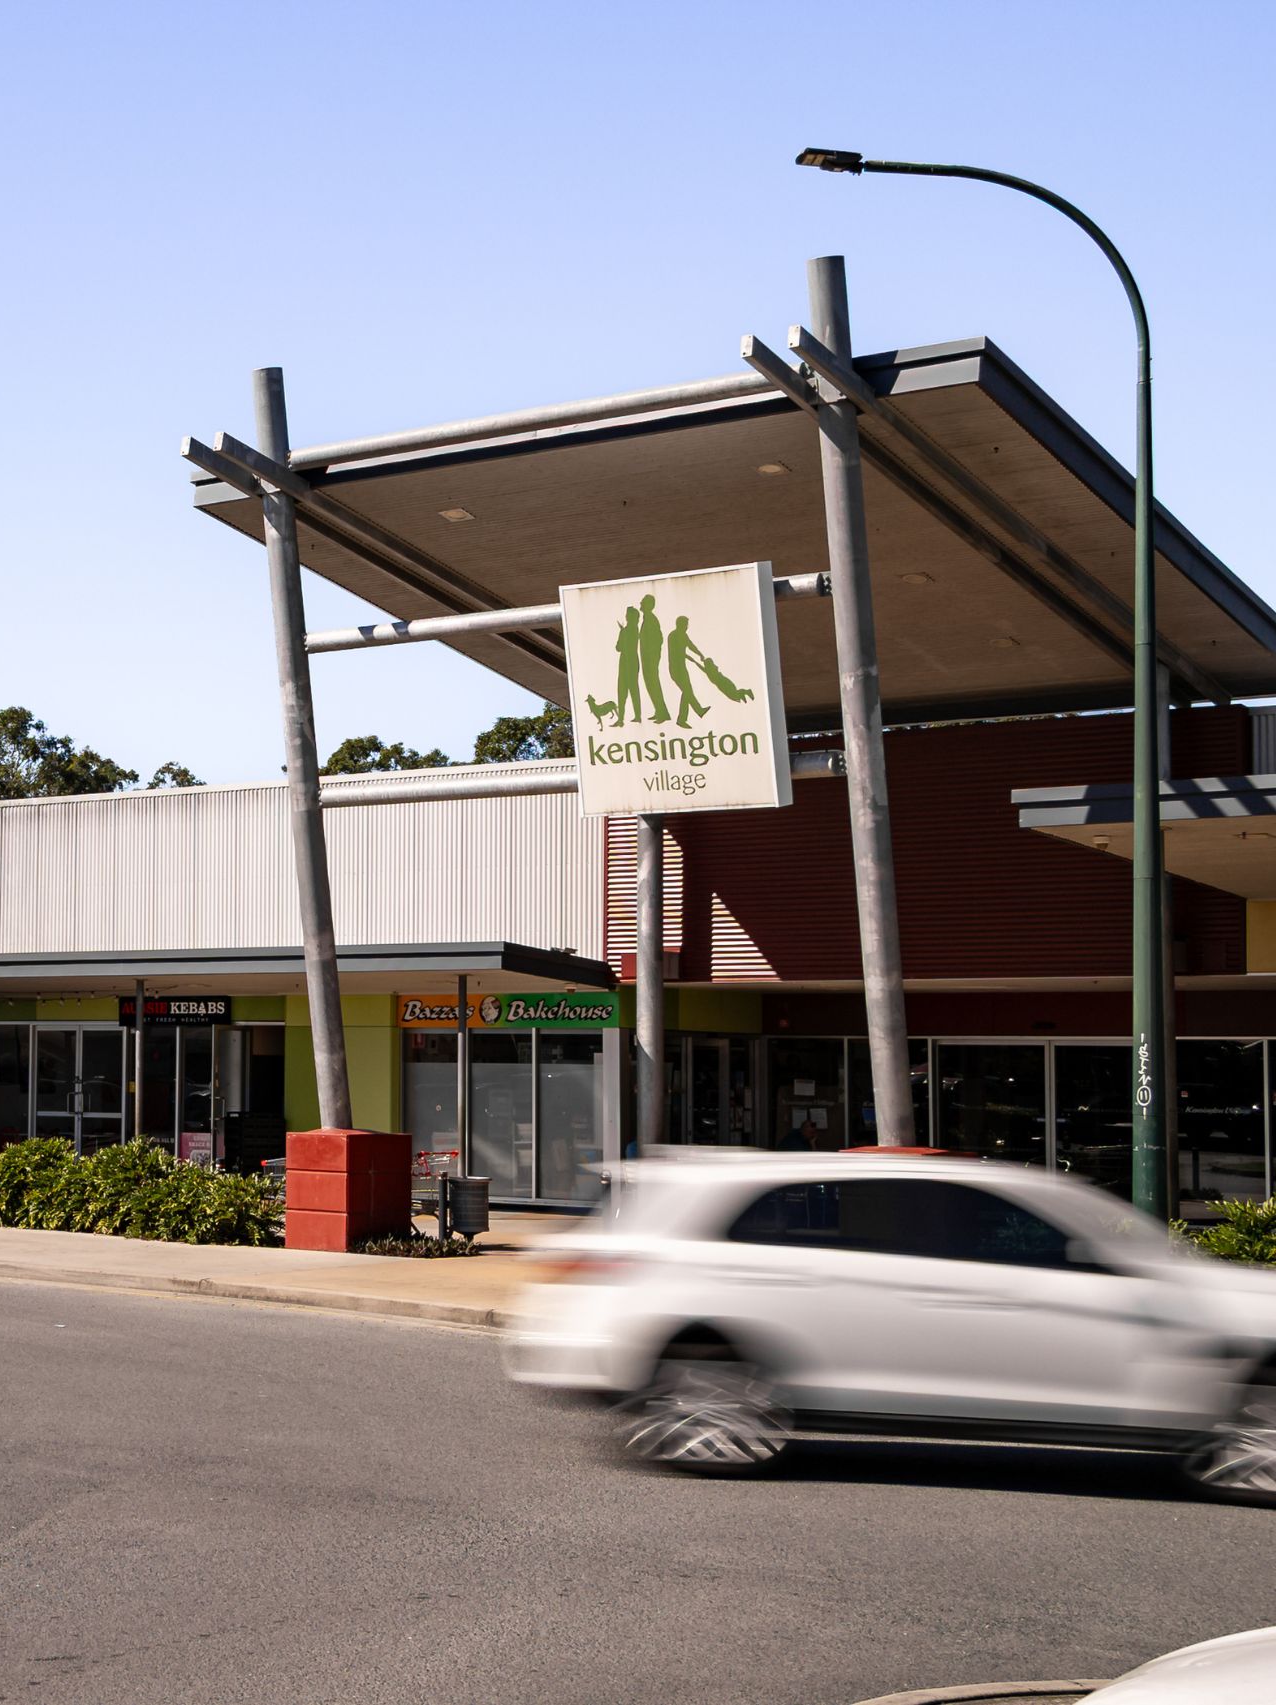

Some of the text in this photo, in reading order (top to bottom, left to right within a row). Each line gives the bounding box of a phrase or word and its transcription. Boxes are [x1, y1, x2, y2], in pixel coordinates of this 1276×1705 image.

[587, 730, 759, 768] kensington
[643, 770, 707, 796] village
[122, 1002, 225, 1015] AUSIE KEBABS
[507, 1000, 613, 1021] Bakehouse
